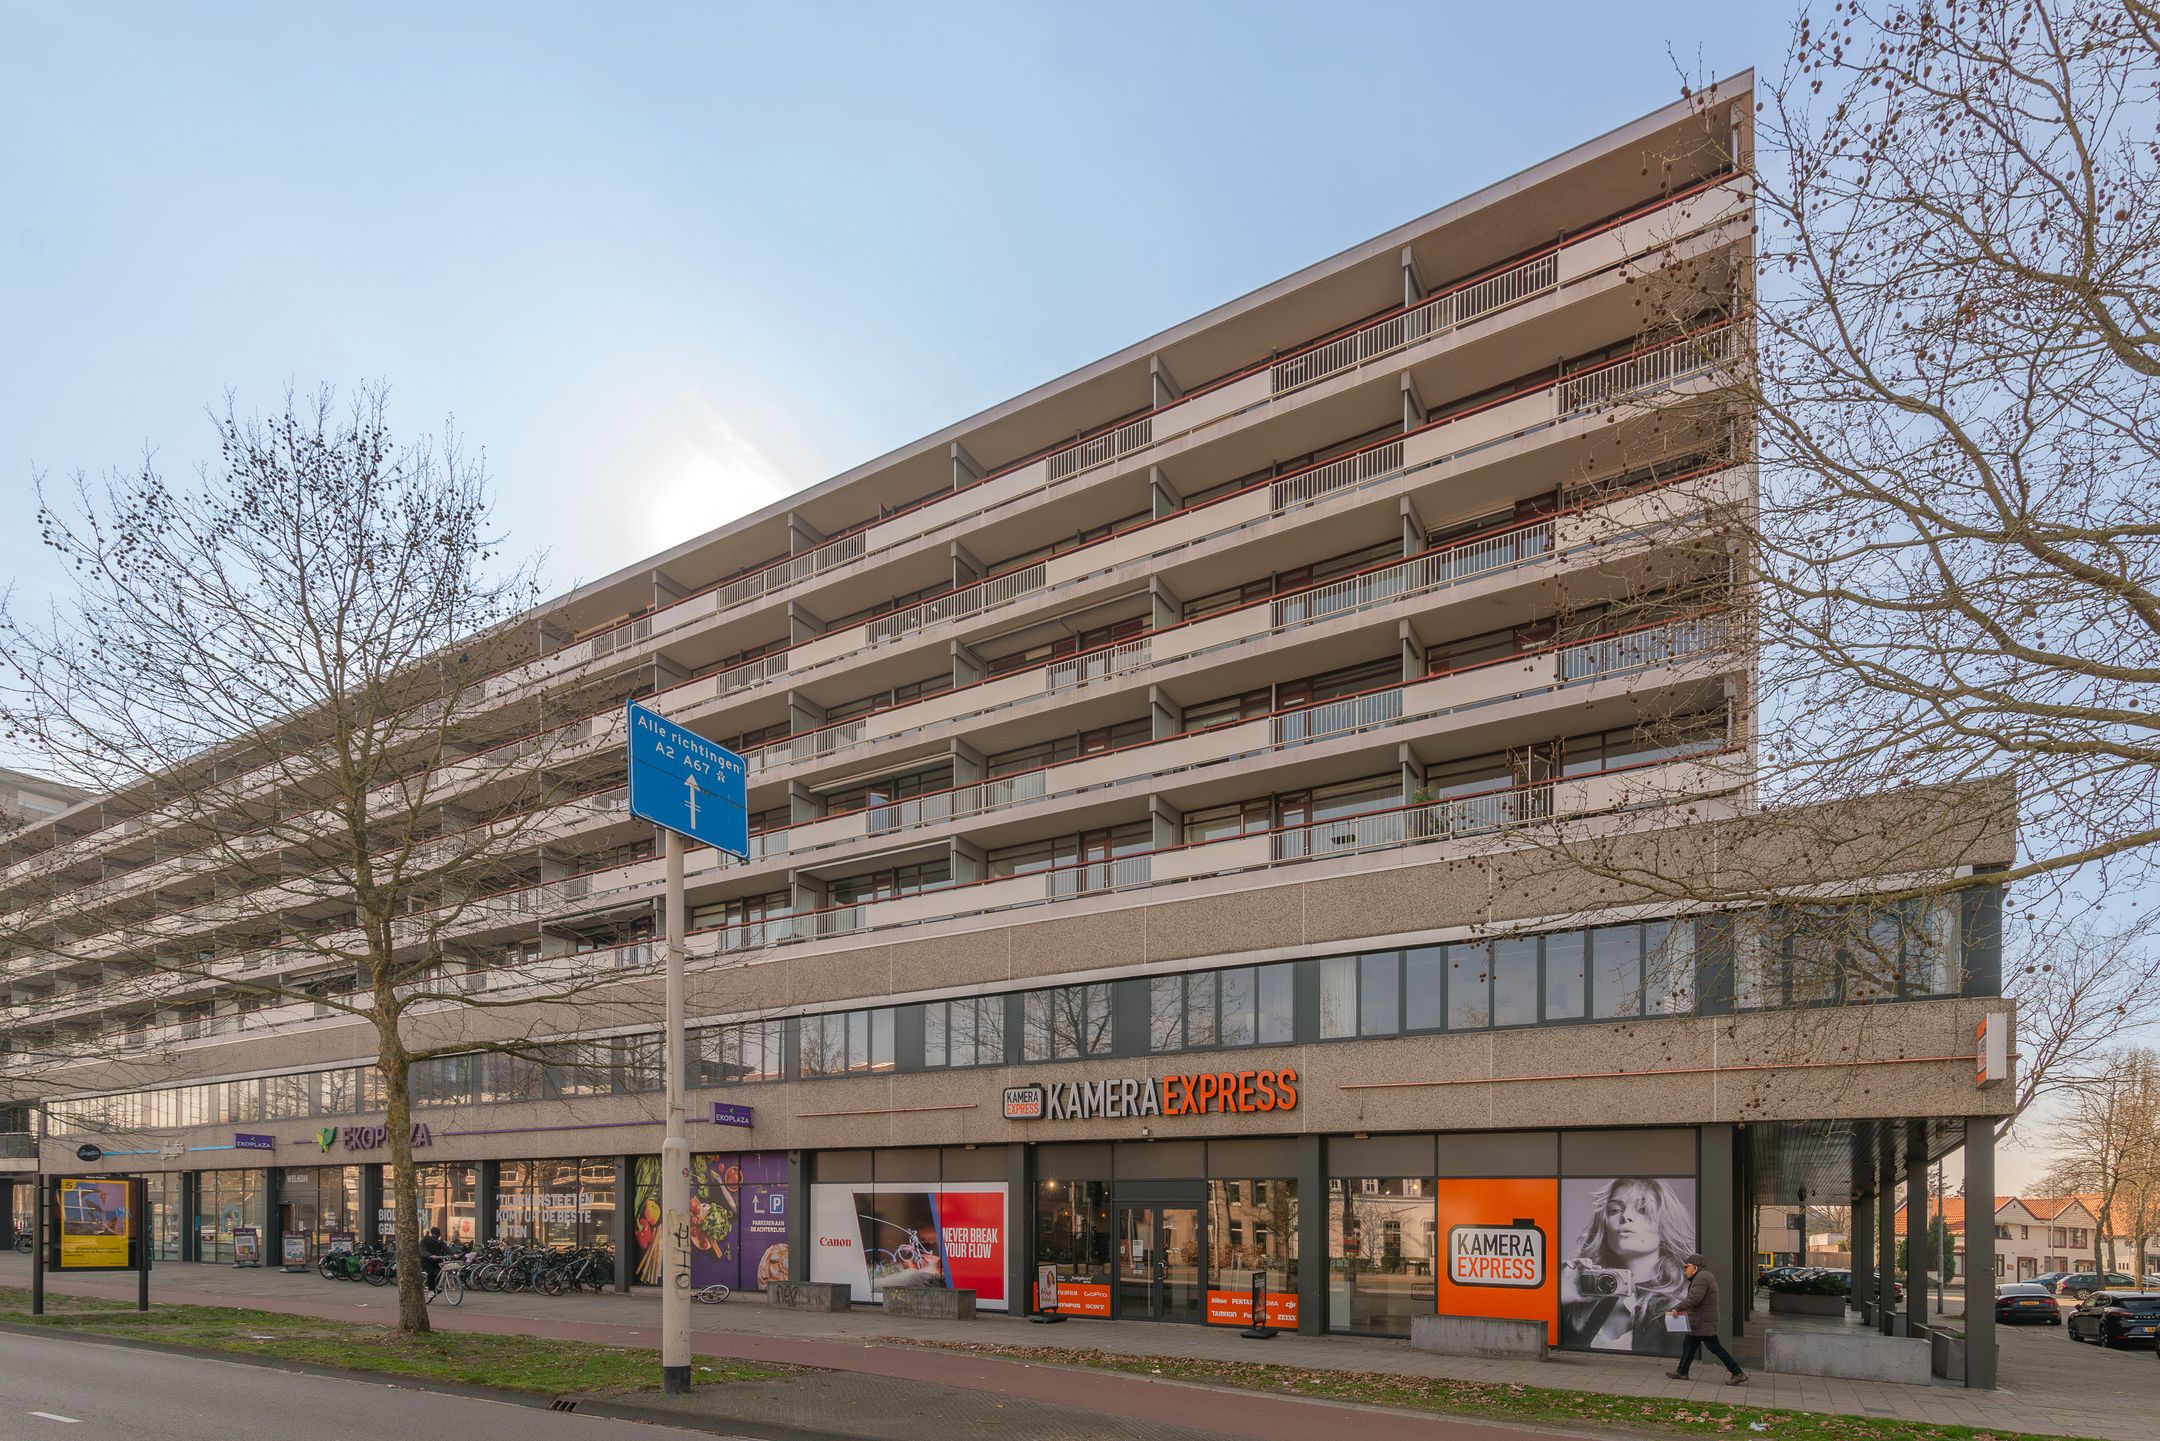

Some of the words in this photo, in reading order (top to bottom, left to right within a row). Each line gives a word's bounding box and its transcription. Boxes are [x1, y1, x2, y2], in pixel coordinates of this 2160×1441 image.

[638, 715, 666, 737] Alle
[671, 733, 741, 774] richtingen
[655, 741, 674, 759] A2
[684, 755, 710, 775] A67
[1006, 1090, 1039, 1103] KAMERA
[1006, 1103, 1039, 1115] EXPRESS
[715, 1113, 750, 1124] EKOPLAZA
[286, 1174, 308, 1183] WELKOM
[542, 1210, 556, 1223] DE
[557, 1210, 592, 1223] BESTE
[819, 1236, 852, 1248] Canon
[942, 1227, 969, 1243] NEVER
[970, 1228, 998, 1244] BREAK
[944, 1243, 967, 1258] YOUR
[968, 1243, 992, 1259] FLOW
[1457, 1233, 1535, 1257] KAMERA
[1457, 1256, 1535, 1280] EXPRESS
